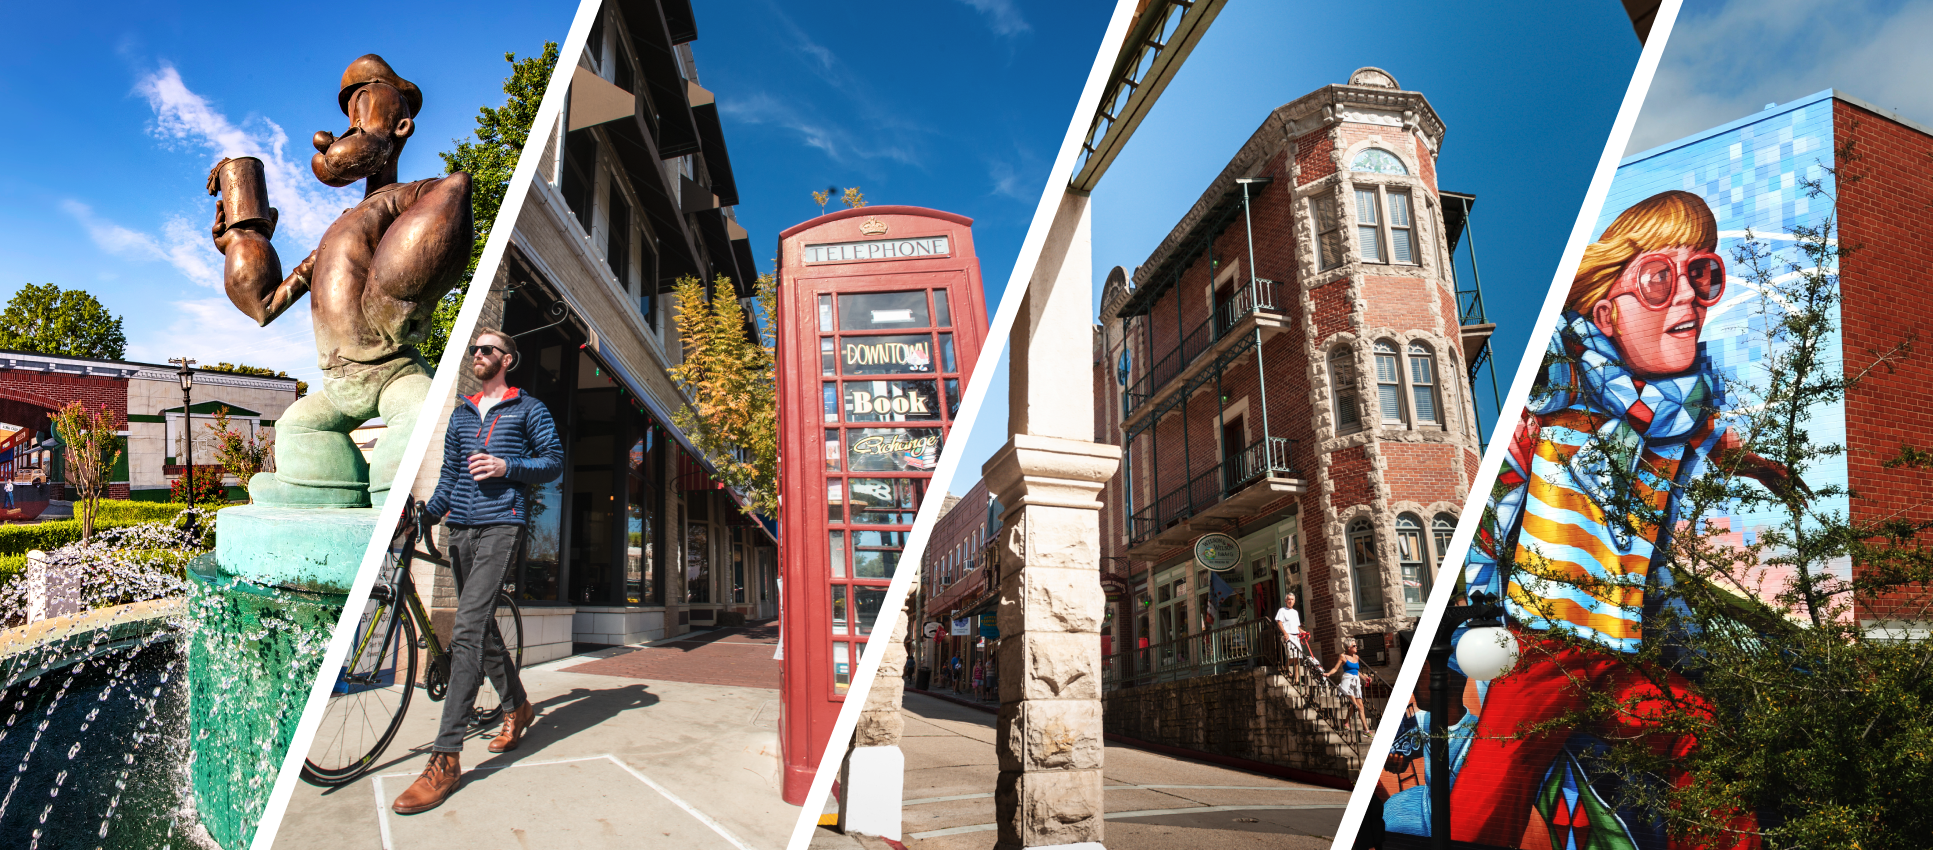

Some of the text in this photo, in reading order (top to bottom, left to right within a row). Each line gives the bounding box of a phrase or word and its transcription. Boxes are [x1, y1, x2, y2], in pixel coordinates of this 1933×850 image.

[810, 239, 944, 262] TELEPHONE
[852, 389, 929, 415] Book
[853, 434, 937, 457] Exchange
